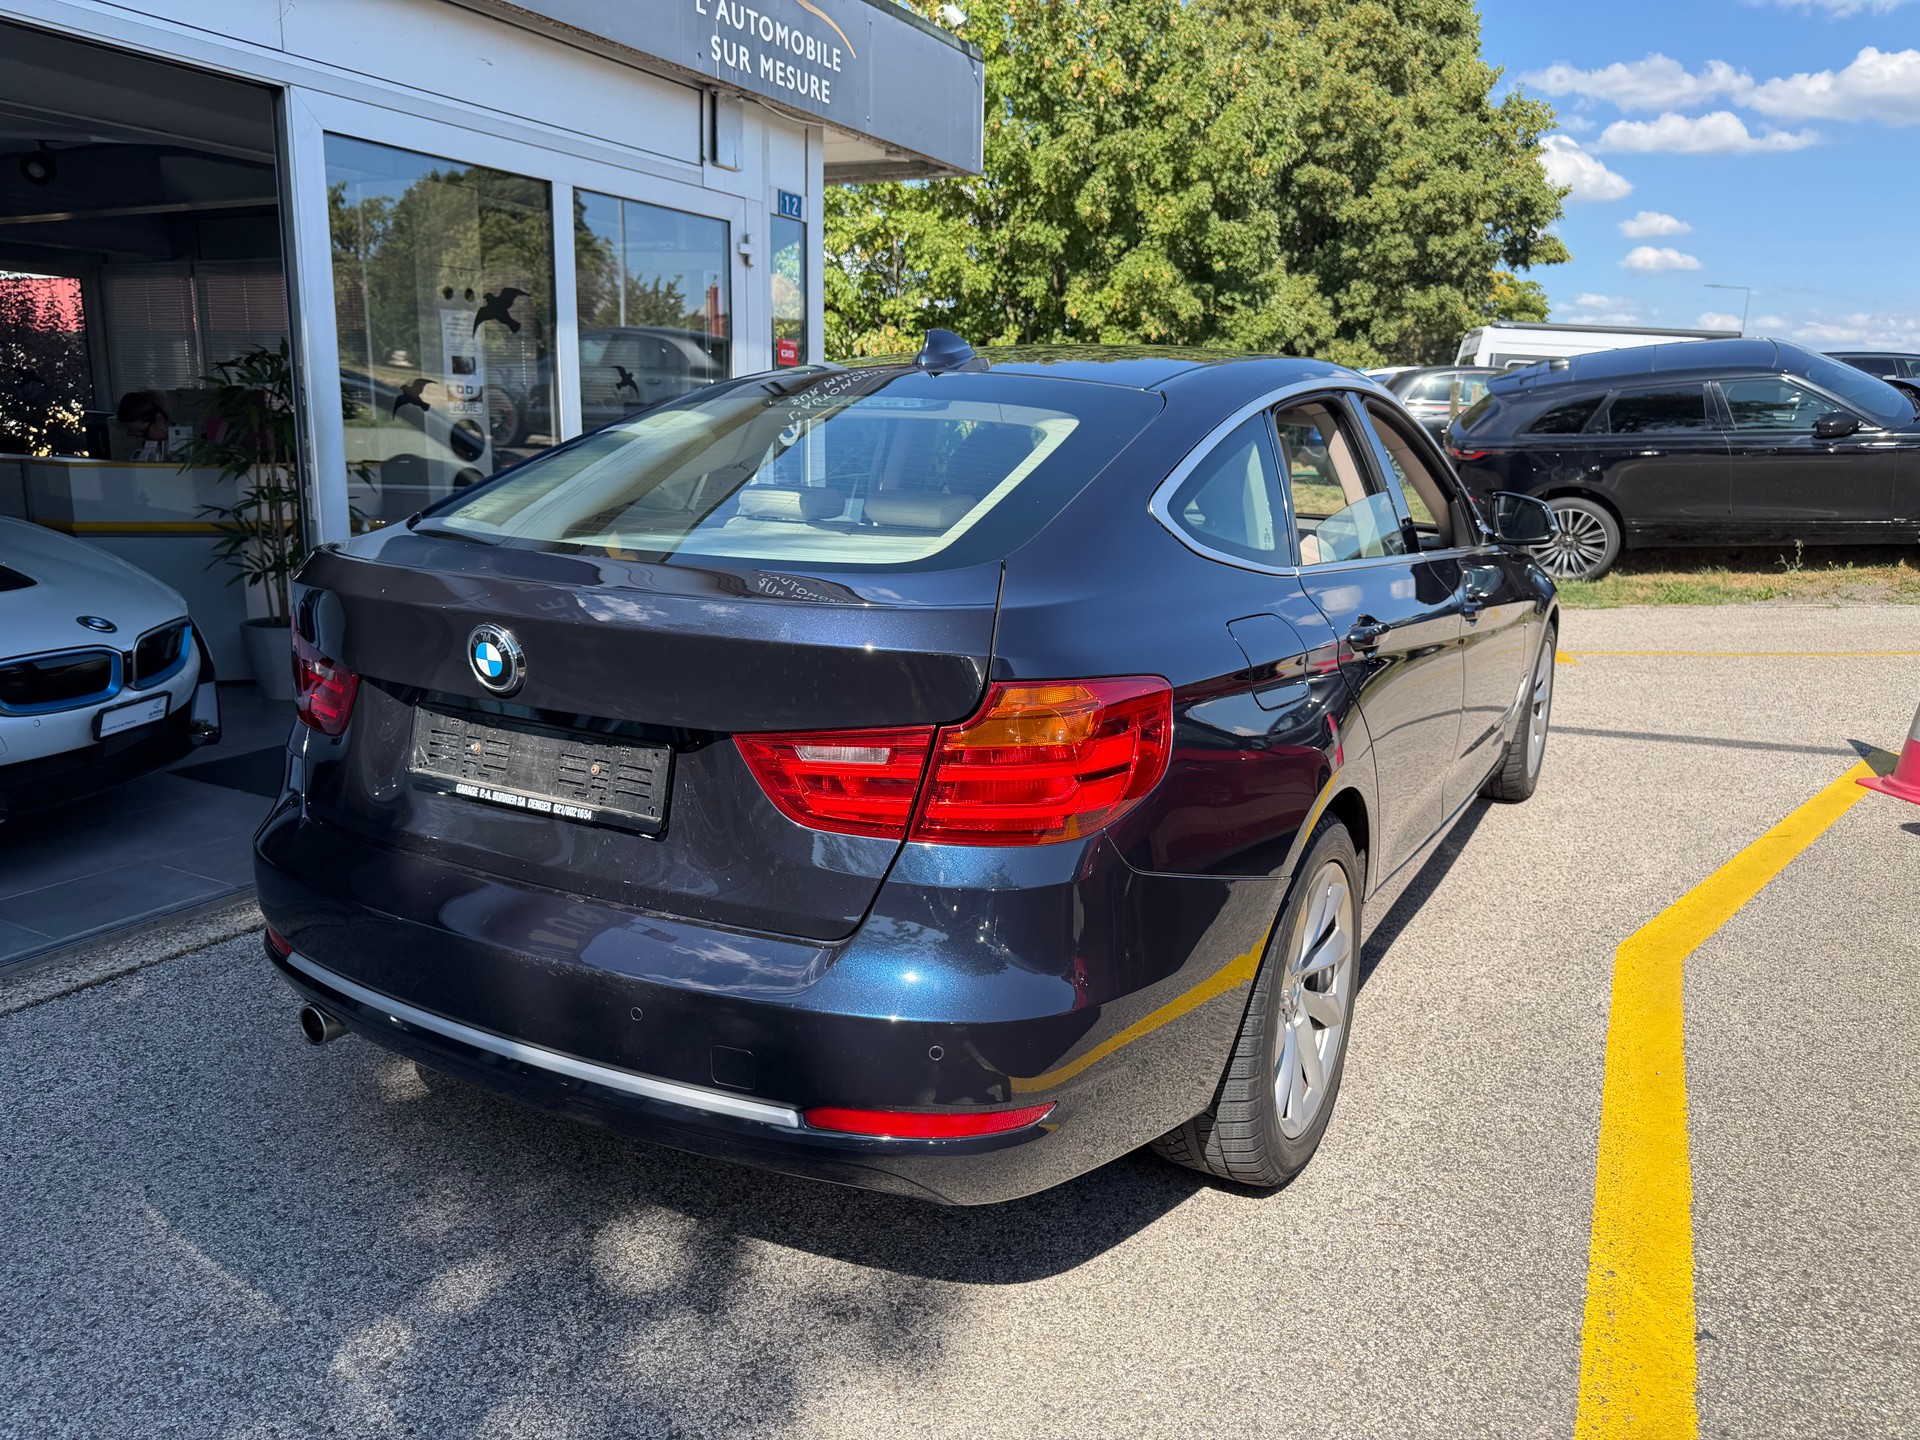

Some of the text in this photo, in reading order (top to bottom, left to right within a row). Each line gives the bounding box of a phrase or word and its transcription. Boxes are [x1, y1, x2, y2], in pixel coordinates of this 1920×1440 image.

[695, 0, 842, 72] L'AUTOMOBILE
[710, 34, 832, 105] SUR MESURE
[784, 195, 799, 217] 12
[455, 783, 479, 797] GARAGE
[517, 796, 526, 808] SA
[527, 799, 552, 813] DENGES
